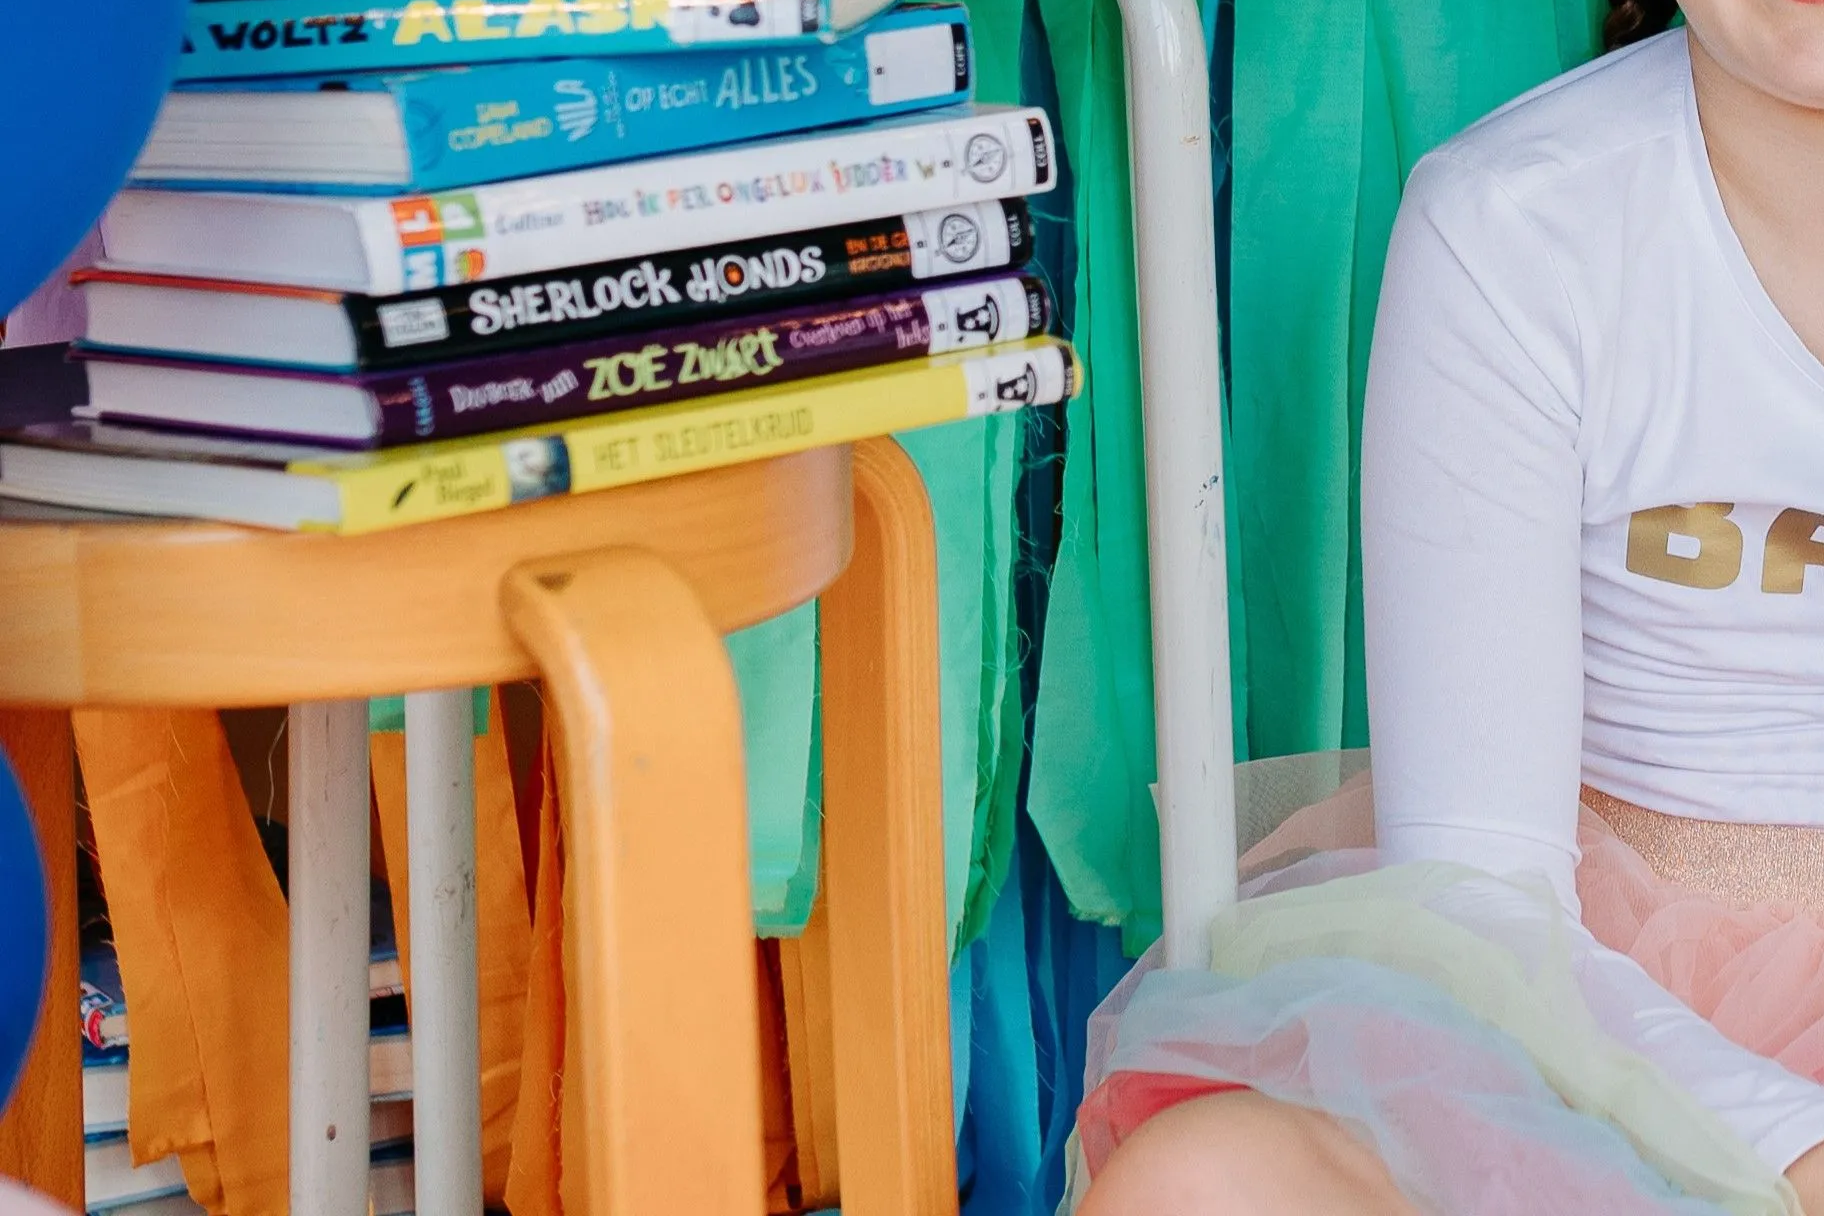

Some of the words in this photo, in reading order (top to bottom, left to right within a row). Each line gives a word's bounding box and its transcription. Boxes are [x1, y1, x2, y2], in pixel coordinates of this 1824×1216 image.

[207, 15, 369, 52] WOLTZ
[714, 54, 820, 111] ALLES
[469, 260, 683, 336] SHERLOCK
[685, 245, 829, 306] HONDS
[673, 327, 784, 386] ZWART
